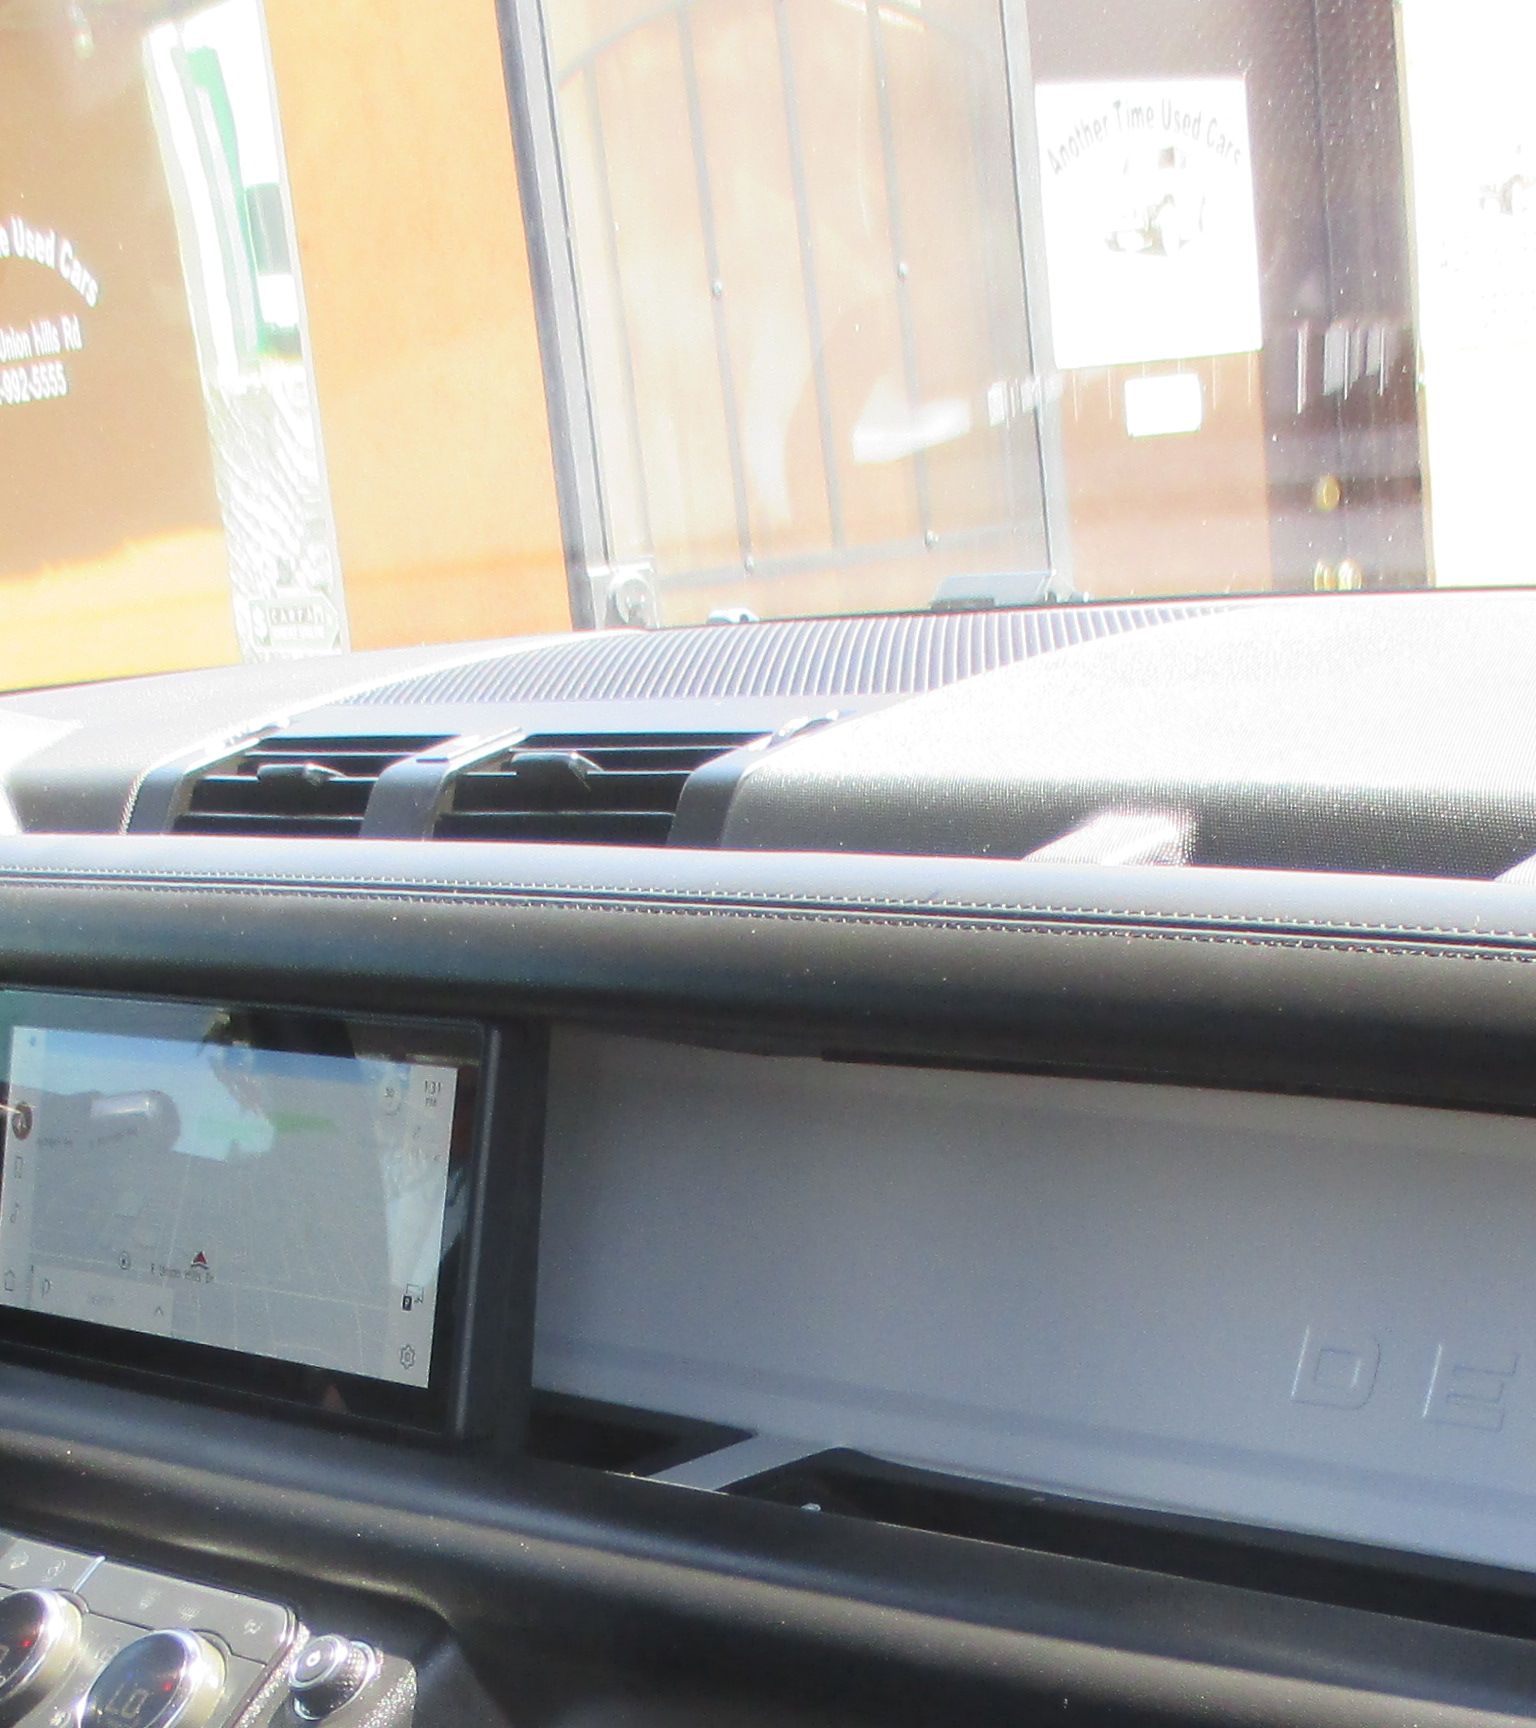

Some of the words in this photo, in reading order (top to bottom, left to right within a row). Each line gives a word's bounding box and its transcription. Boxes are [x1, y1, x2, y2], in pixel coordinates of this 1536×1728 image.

[1046, 115, 1110, 175] Another
[1112, 99, 1155, 130] Time
[1161, 97, 1202, 141] Used
[1206, 117, 1242, 165] Cars
[11, 216, 56, 269] Used
[59, 239, 99, 307] Cars
[61, 314, 83, 351] Rd
